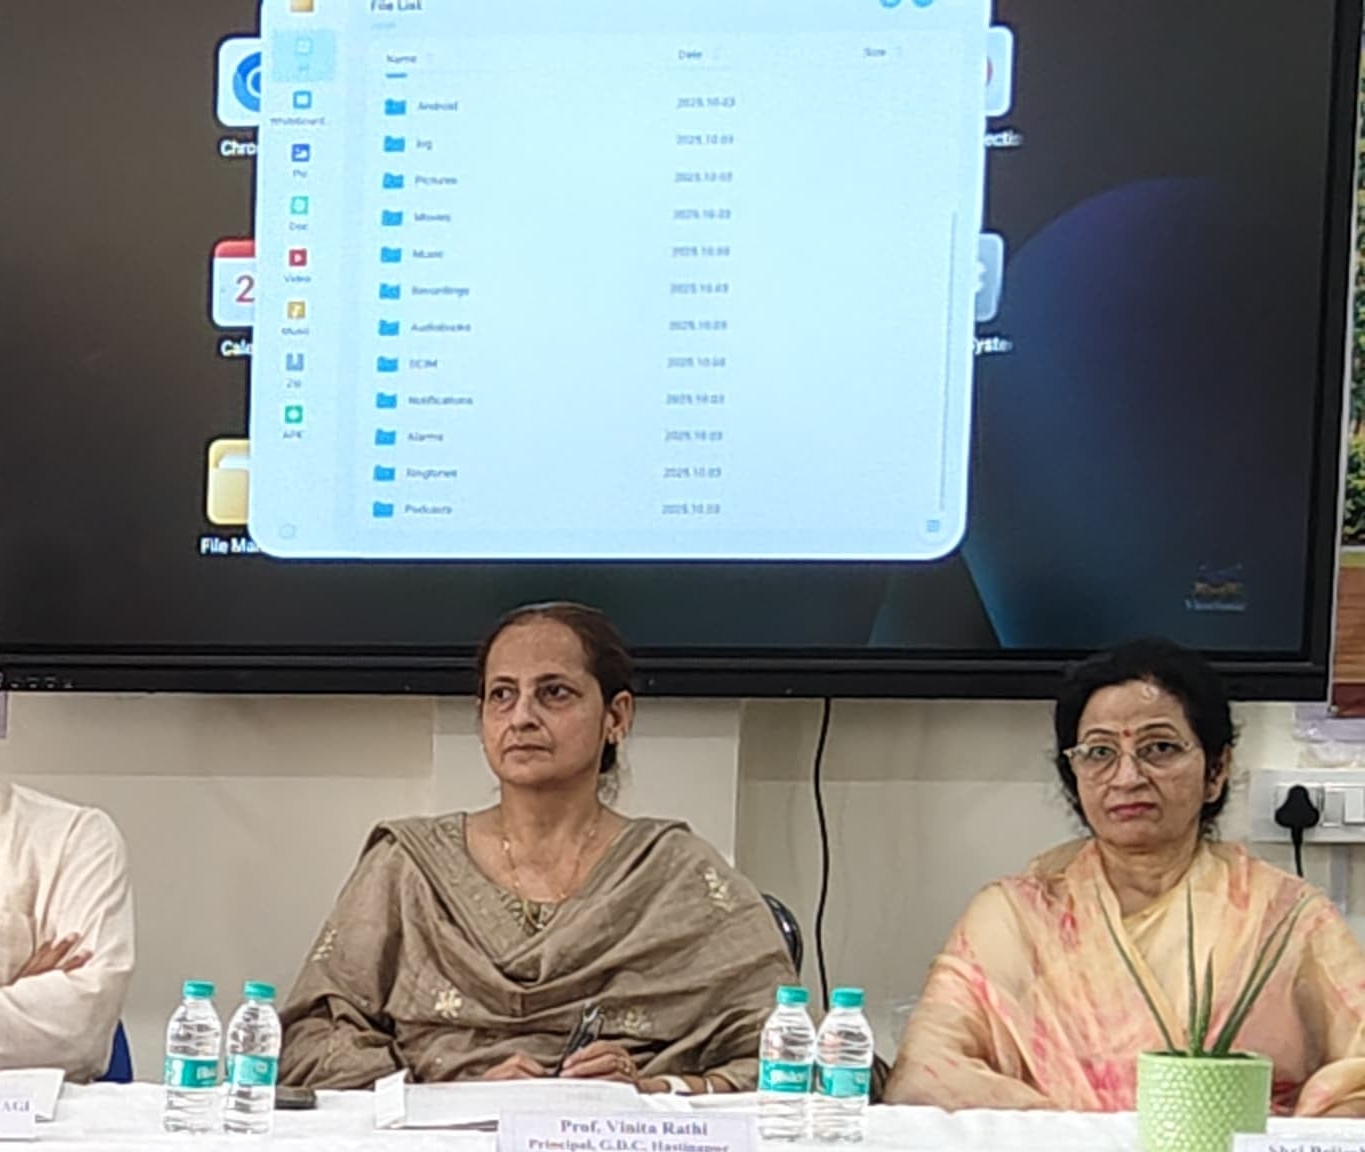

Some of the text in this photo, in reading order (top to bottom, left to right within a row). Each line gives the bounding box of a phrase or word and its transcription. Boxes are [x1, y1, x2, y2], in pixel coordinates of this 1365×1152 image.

[200, 537, 228, 555] File
[561, 1119, 709, 1136] Prof. Vinita Rathi
